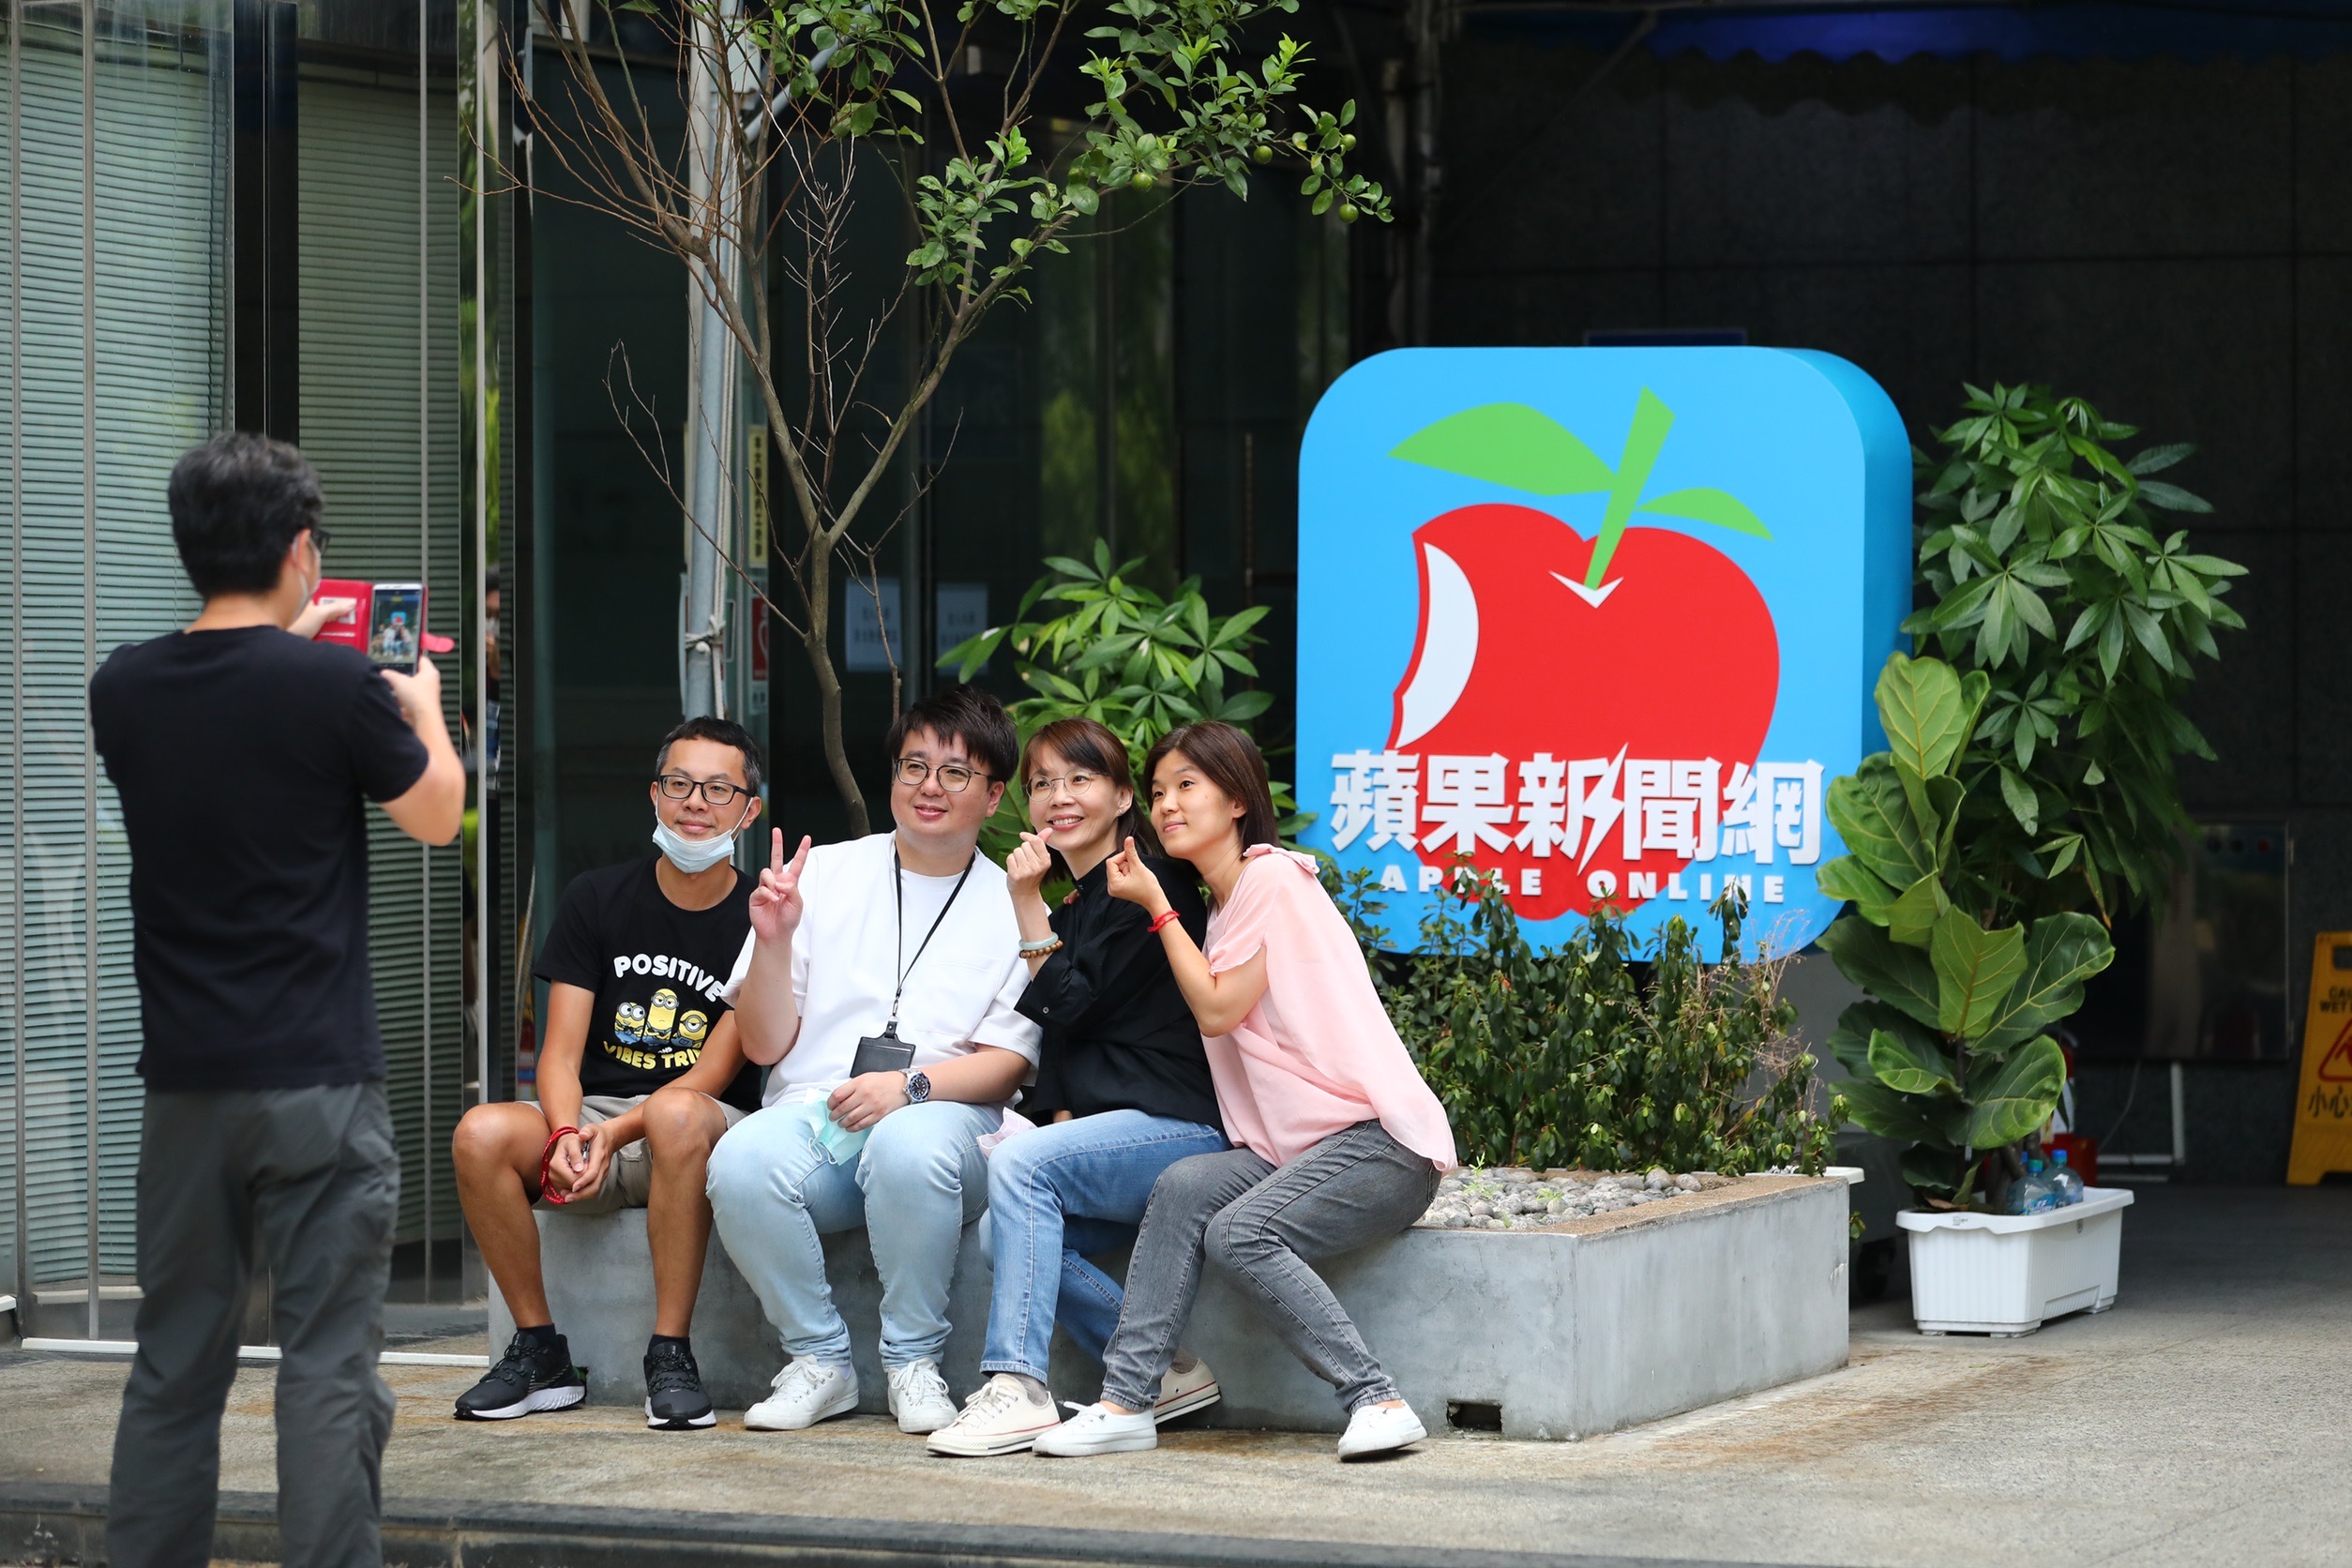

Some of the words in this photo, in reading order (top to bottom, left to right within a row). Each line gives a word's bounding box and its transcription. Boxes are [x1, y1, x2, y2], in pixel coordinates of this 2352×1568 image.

[1330, 742, 1825, 876] 蘋果新聞網
[613, 953, 725, 1003] POSITIVE
[603, 1040, 656, 1070] VIBES
[2307, 1084, 2352, 1119] 小心
